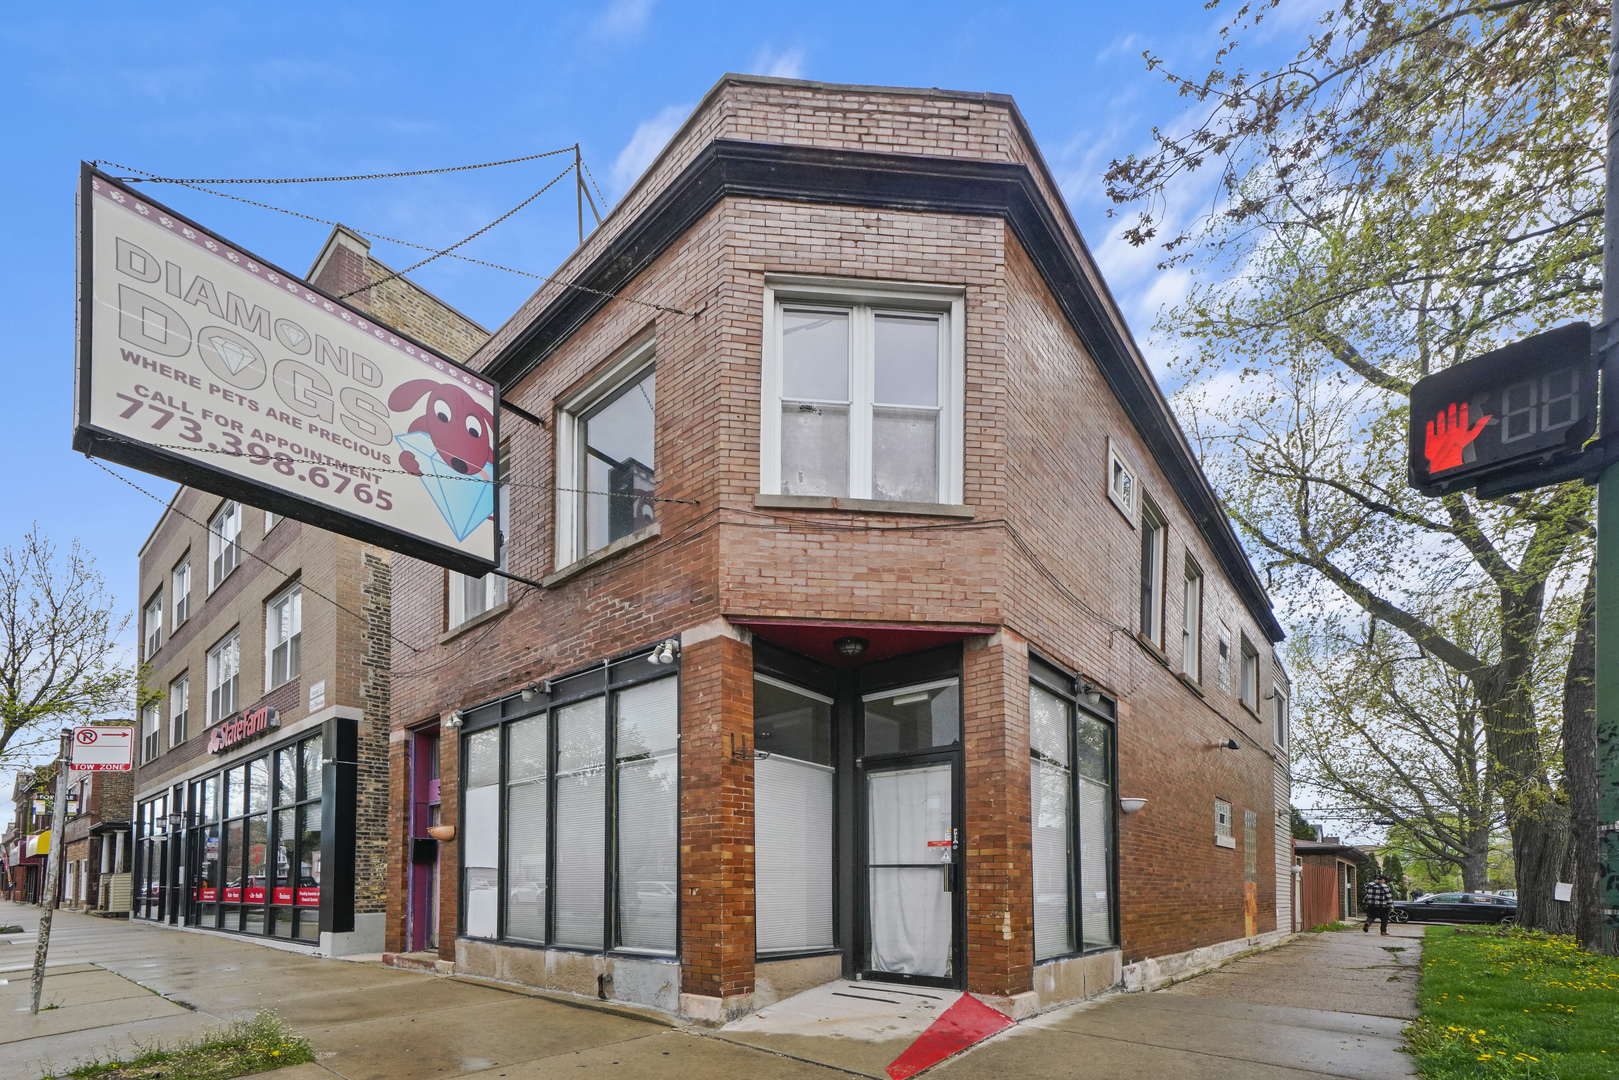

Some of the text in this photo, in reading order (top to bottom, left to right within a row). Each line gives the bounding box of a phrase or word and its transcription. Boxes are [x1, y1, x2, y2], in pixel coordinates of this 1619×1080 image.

[115, 236, 383, 388] DIAMOND
[118, 283, 393, 446] DOGS
[116, 392, 393, 511] 773.398.6765
[120, 347, 391, 465] WHERE PETS ARE PRECIOUS
[133, 384, 382, 485] CALL FOR APPOINTMENT
